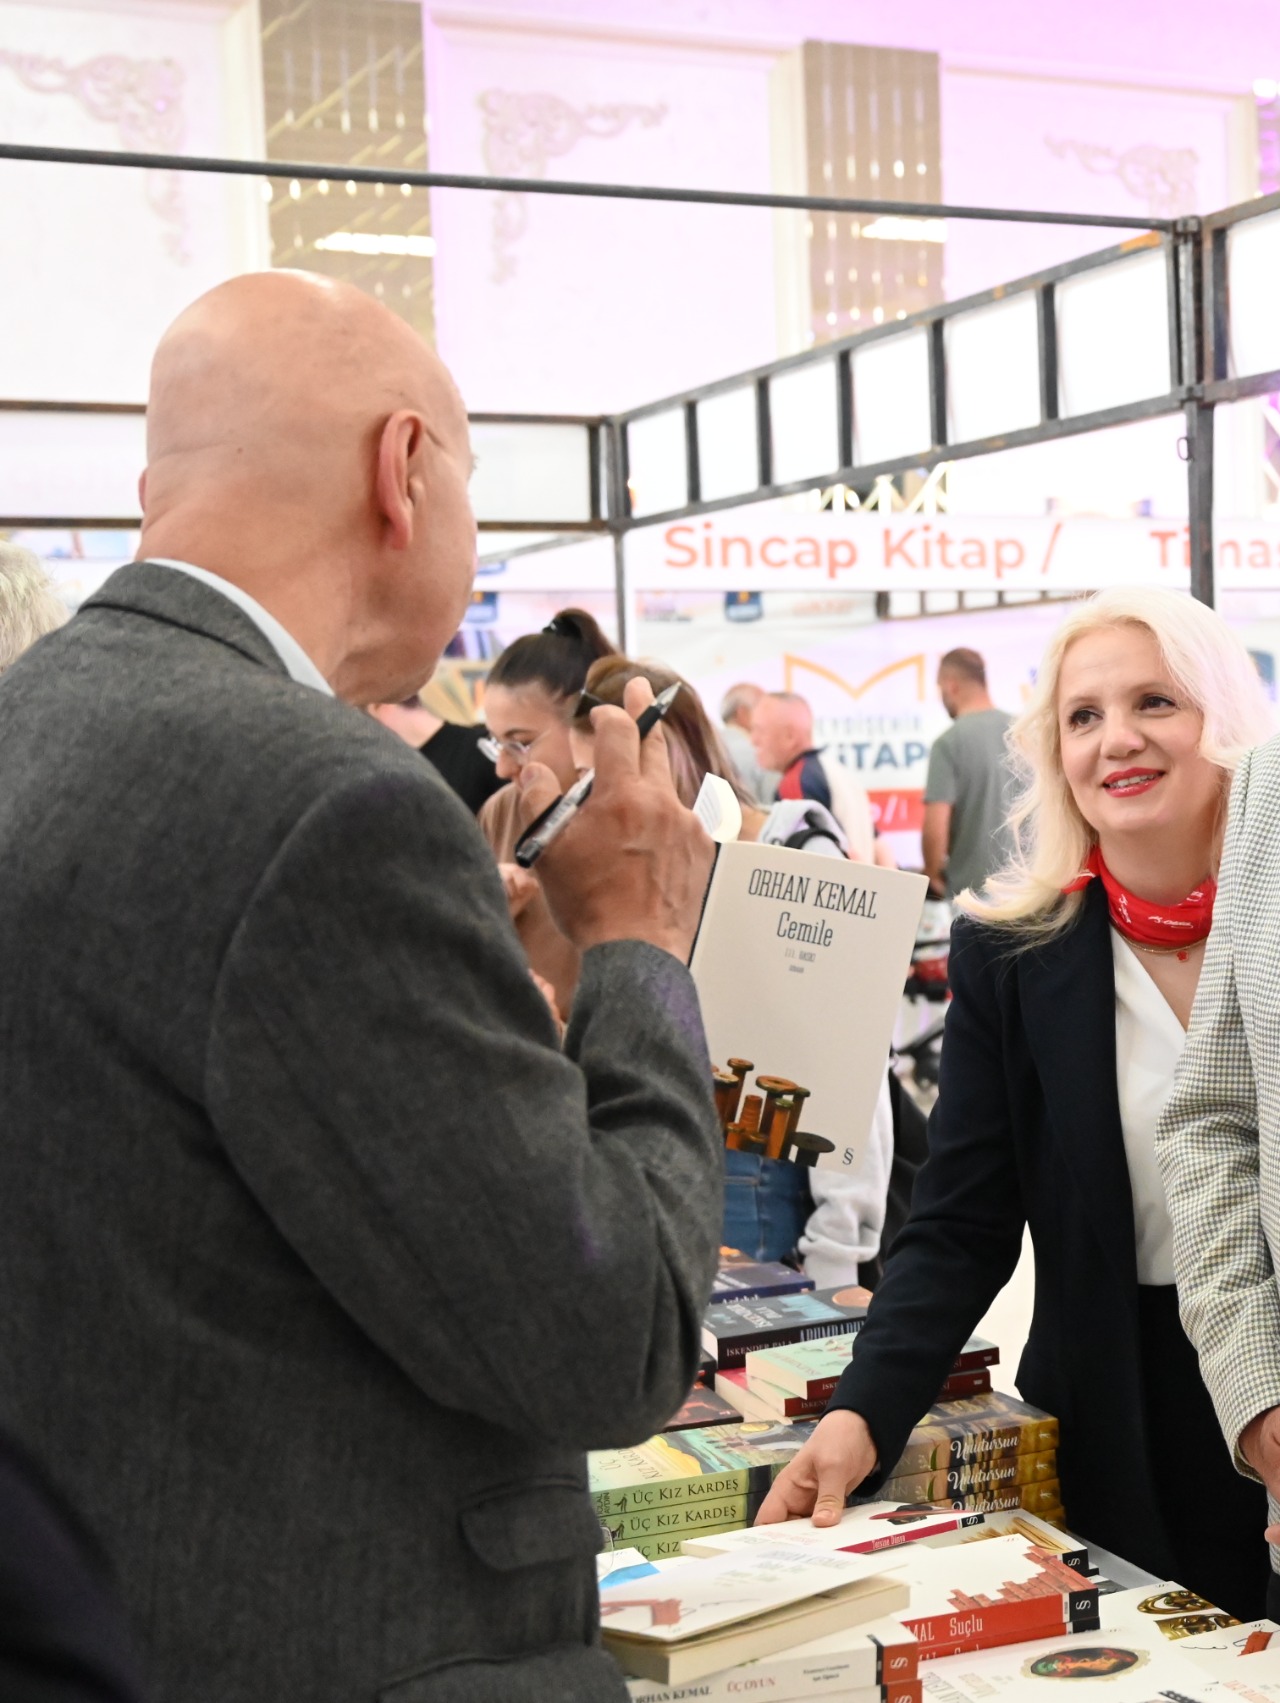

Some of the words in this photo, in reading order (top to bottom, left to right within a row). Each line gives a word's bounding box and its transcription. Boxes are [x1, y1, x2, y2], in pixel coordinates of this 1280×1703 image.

[664, 521, 858, 580] Sincap
[882, 523, 1024, 578] Kitap
[748, 868, 812, 904] ORHAN
[813, 880, 878, 919] KEMAL
[776, 911, 834, 947] Cemile
[632, 1489, 654, 1505] ÜÇ
[659, 1487, 683, 1501] KIZ
[687, 1478, 740, 1496] KARDEŞ
[630, 1516, 651, 1531] ÜÇ
[656, 1513, 680, 1527] KIZ
[685, 1505, 737, 1523] KARDEŞ
[949, 1614, 983, 1639] Suçlu
